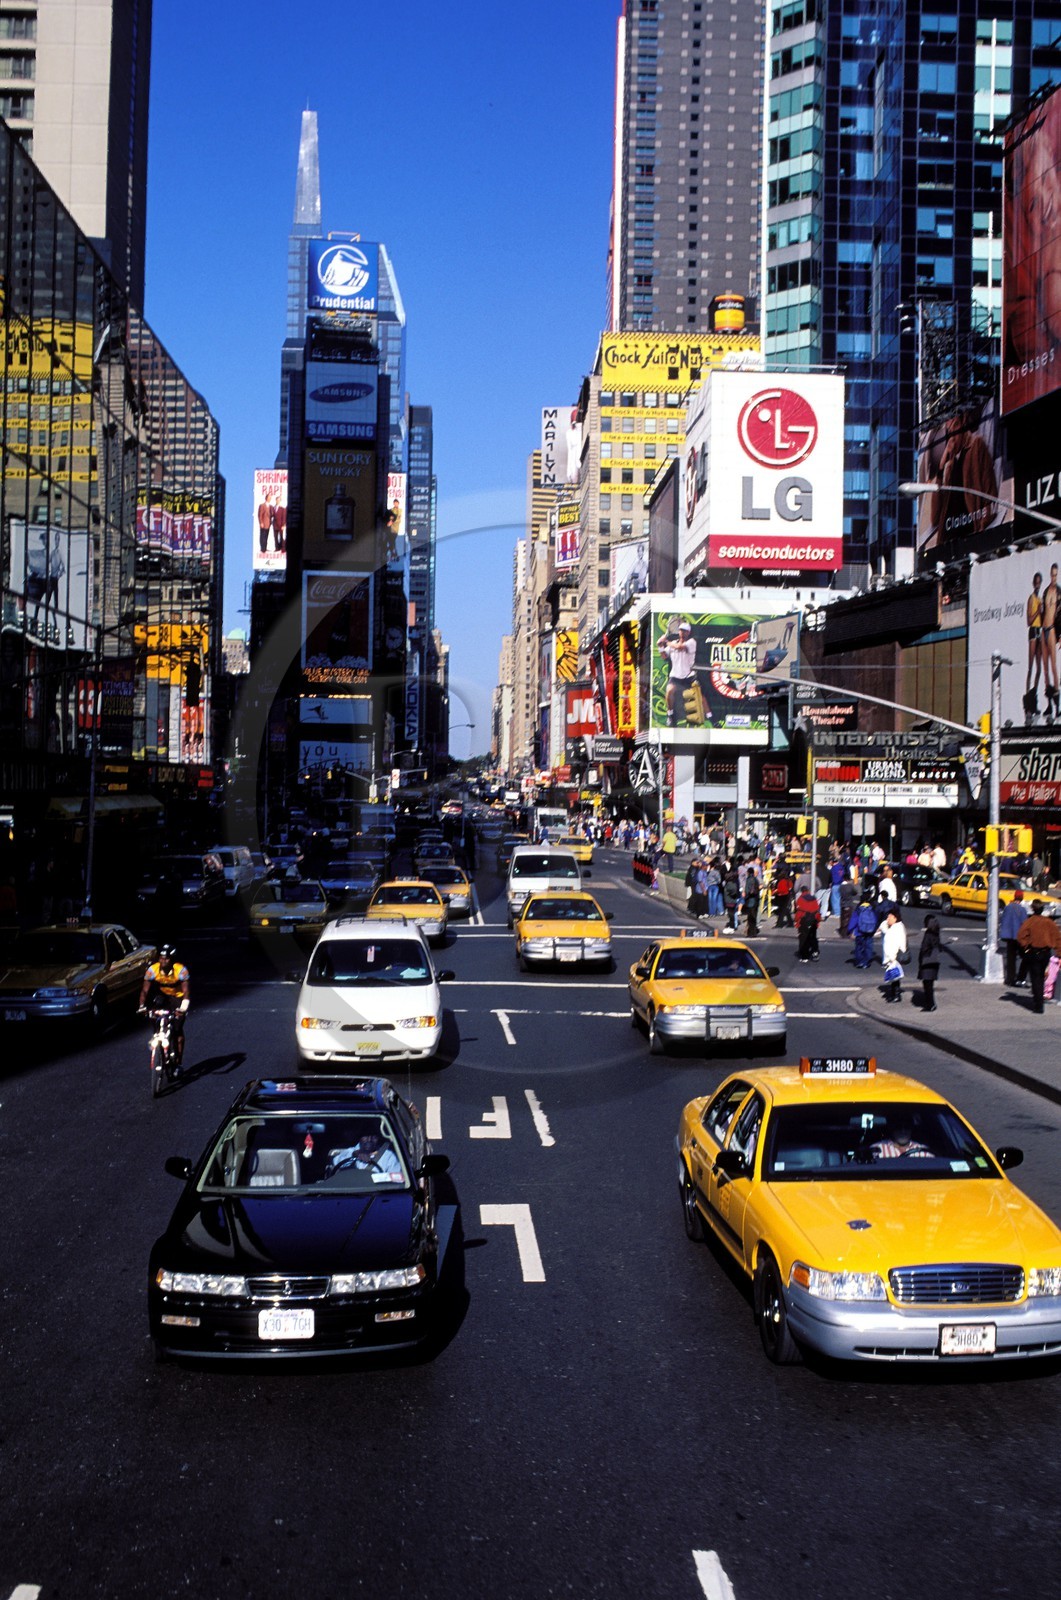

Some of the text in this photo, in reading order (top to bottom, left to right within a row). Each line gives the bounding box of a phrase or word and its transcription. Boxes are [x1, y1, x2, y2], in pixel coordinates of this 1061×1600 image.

[312, 295, 375, 310] Prudential
[604, 345, 641, 368] Chock
[1007, 347, 1055, 385] Dresses
[317, 387, 367, 398] SAMSUNG
[308, 423, 374, 437] SAMSUNG
[543, 408, 559, 483] MARILYN
[308, 451, 371, 465] SUNTORY
[319, 466, 361, 477] WHISKY
[261, 484, 283, 496] RAP!
[1026, 471, 1056, 509] LIZ
[741, 475, 813, 522] LG
[559, 511, 580, 524] BEST
[945, 505, 988, 531] Claiborne
[717, 543, 835, 561] semiconductors
[973, 600, 1025, 625] Broadway Jockey
[705, 636, 724, 644] play
[712, 646, 732, 663] ALL
[406, 677, 418, 737] NOKIA
[801, 705, 855, 717] Roundabout
[810, 715, 846, 727] Theatre
[813, 731, 939, 746] UNITED ARTISTS
[303, 745, 338, 766] you
[884, 746, 938, 760] Theatres
[867, 761, 903, 770] URBAN
[864, 768, 906, 779] LEGEND
[842, 785, 881, 793] NEGOTIATOR
[1010, 783, 1057, 801] the Italian
[825, 1059, 853, 1072] 3H80
